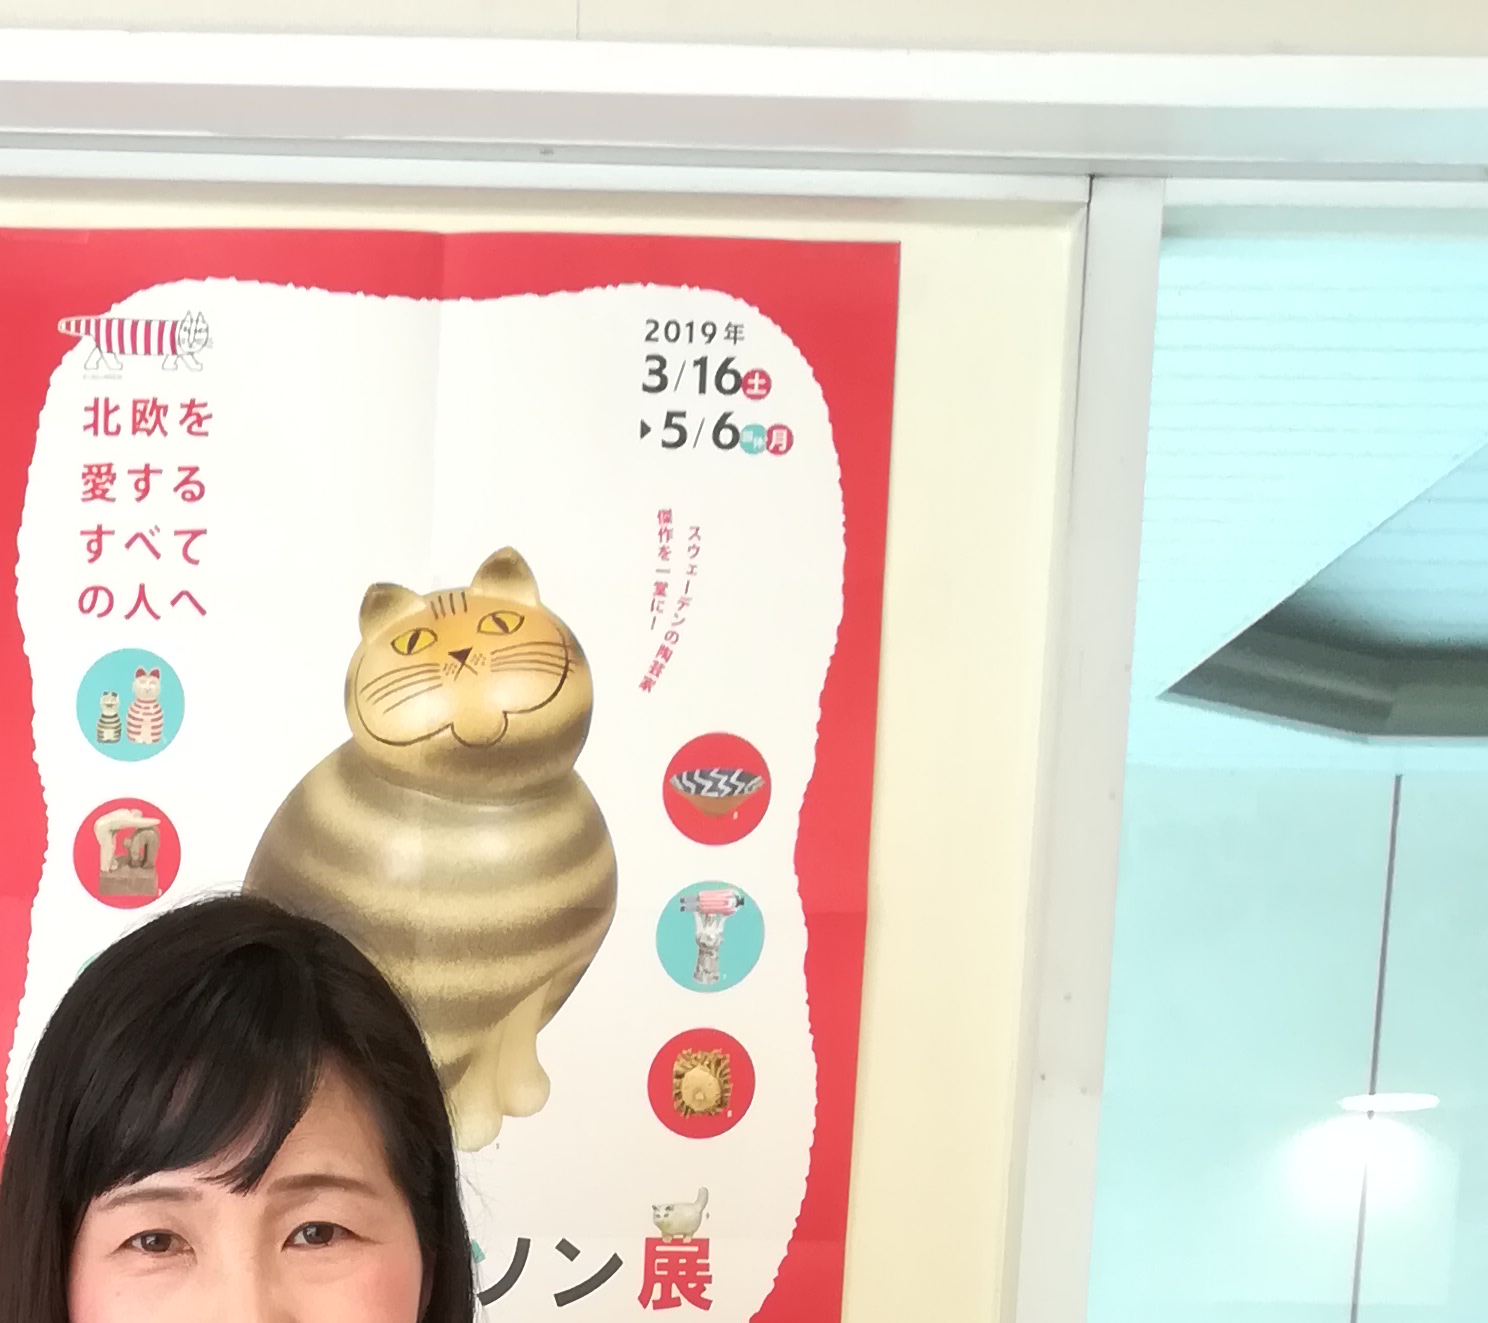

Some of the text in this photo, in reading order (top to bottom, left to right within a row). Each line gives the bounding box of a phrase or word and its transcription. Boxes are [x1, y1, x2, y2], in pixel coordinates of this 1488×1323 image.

[644, 318, 745, 345] 2019年
[83, 396, 214, 438] 北欧を
[80, 462, 207, 504] 愛する
[79, 523, 208, 566] すべて
[78, 583, 208, 621] の人へ
